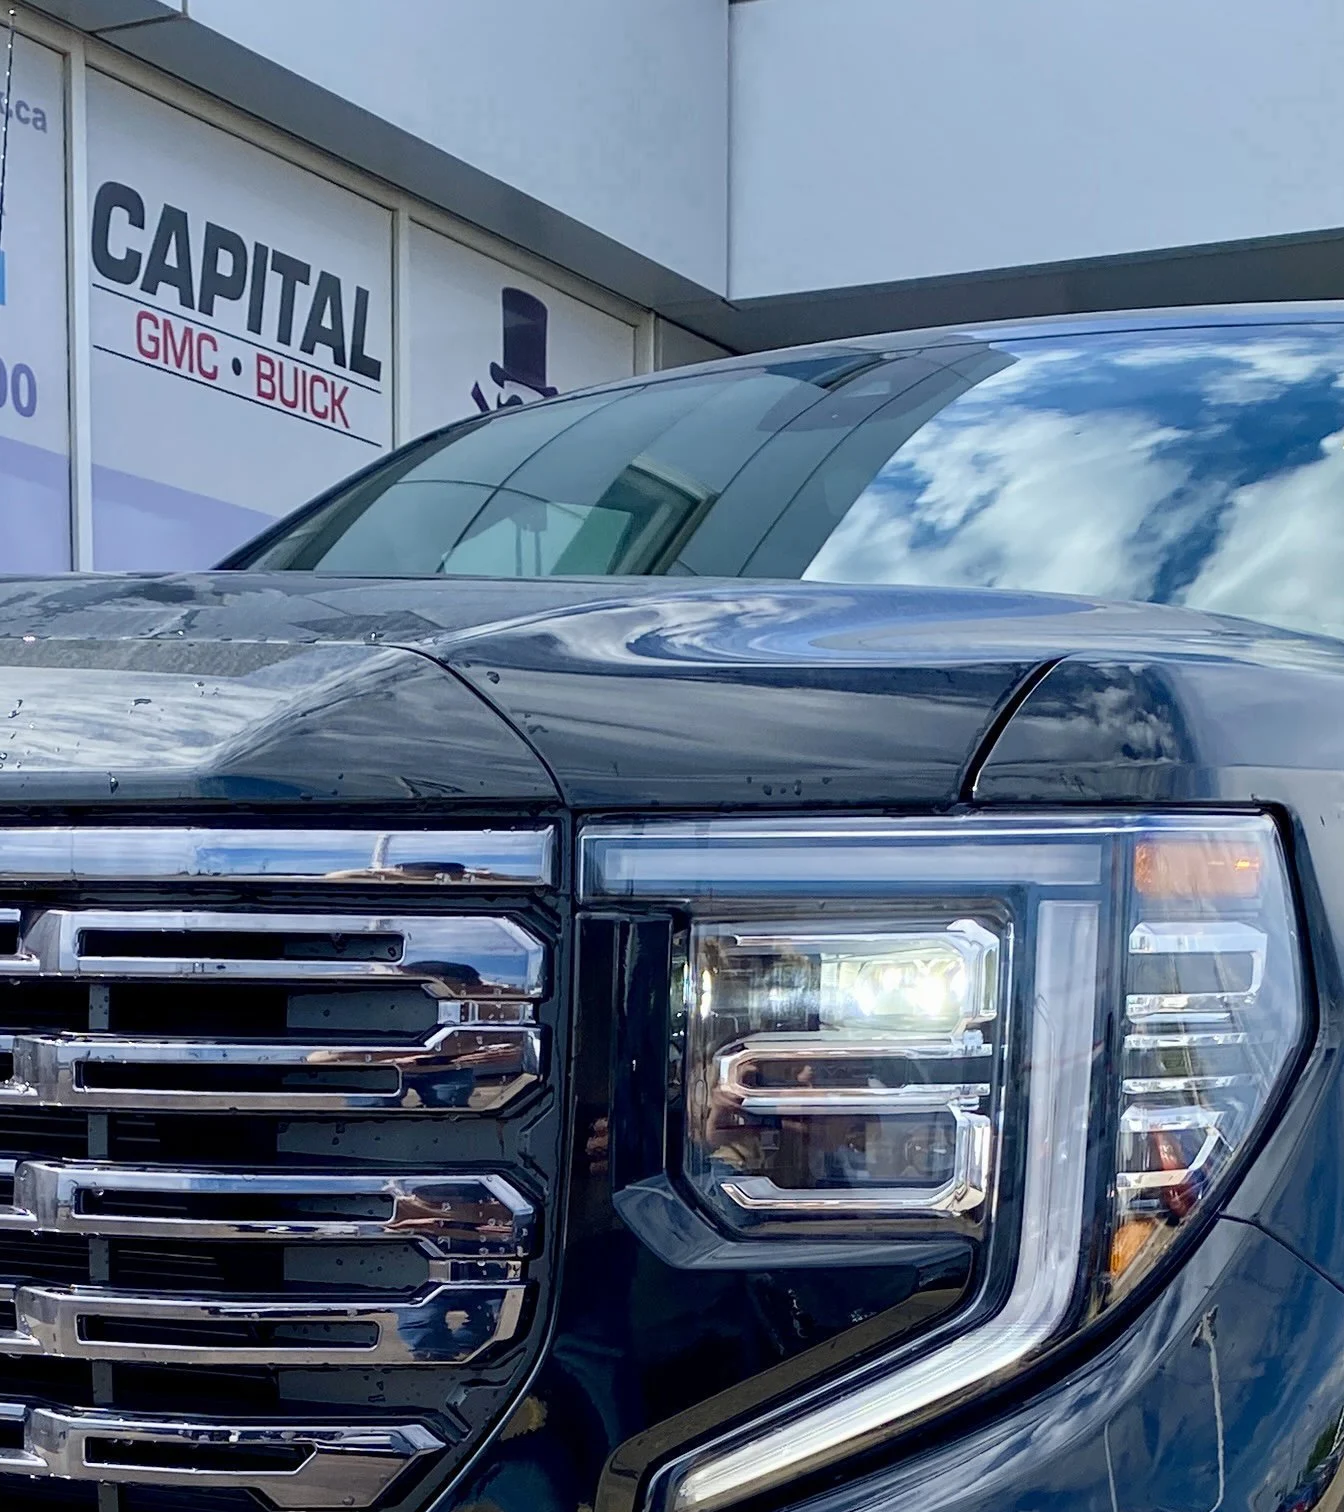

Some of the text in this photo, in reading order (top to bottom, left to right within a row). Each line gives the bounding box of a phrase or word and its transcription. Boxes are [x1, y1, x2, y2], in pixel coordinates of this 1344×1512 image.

[91, 180, 383, 382] CAPITAL
[136, 309, 352, 430] GMC BUICK
